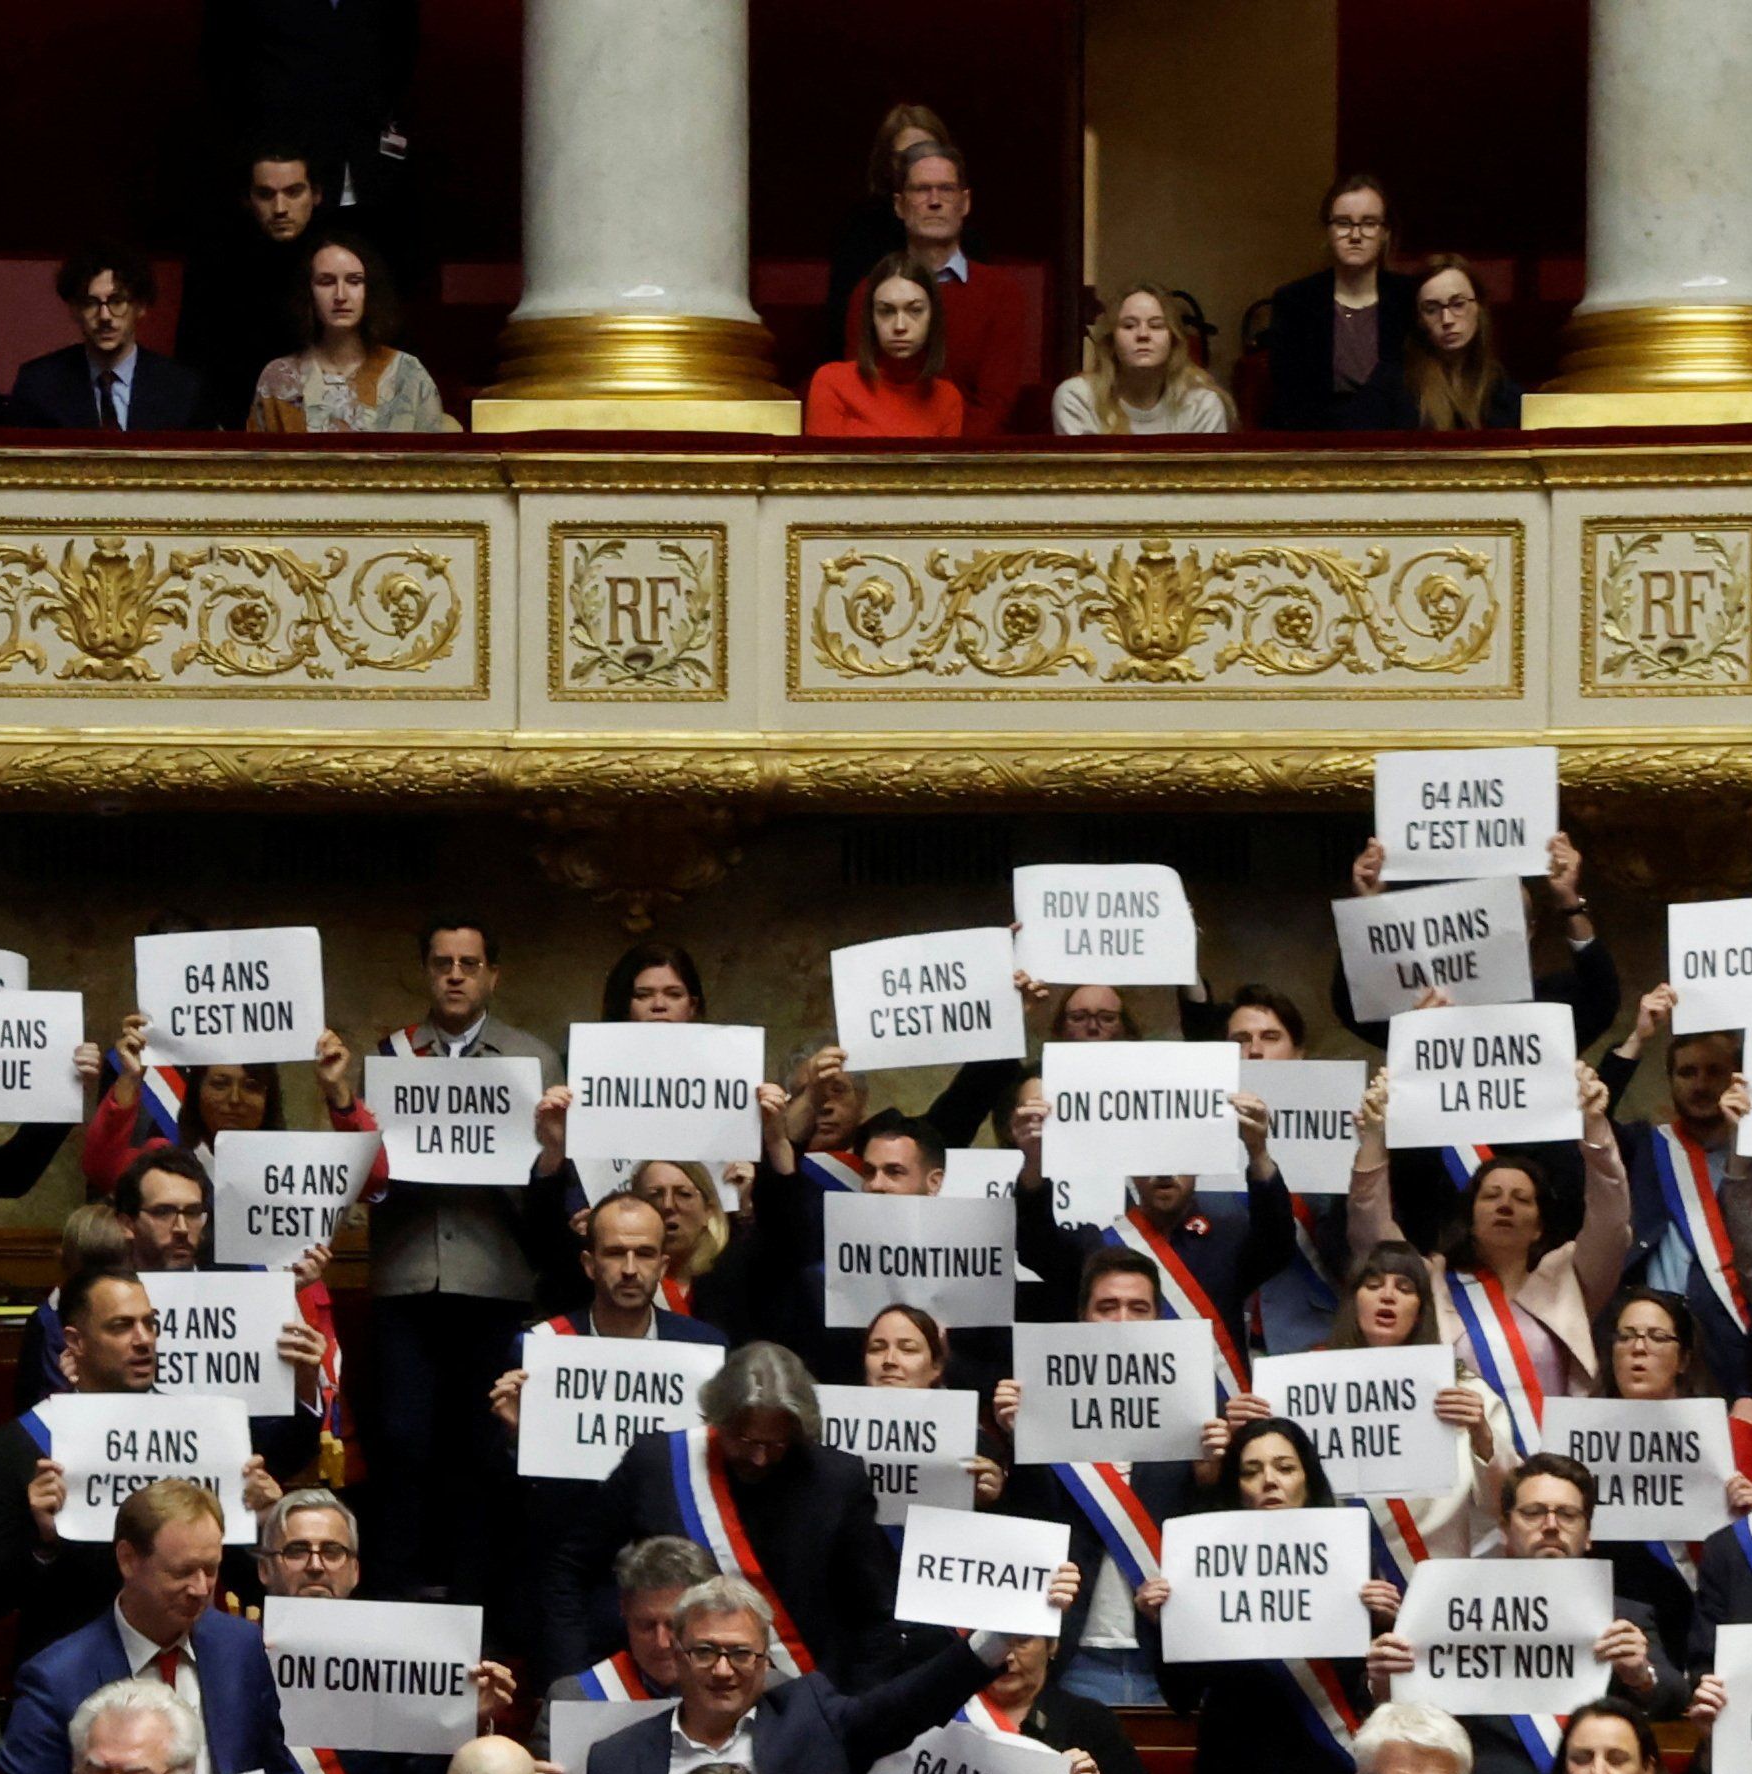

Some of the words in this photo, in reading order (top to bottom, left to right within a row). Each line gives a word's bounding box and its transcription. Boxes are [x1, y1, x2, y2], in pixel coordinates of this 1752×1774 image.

[604, 576, 681, 646] RF
[1638, 570, 1715, 640] RF
[186, 965, 215, 993] 64
[223, 961, 269, 991] ANS
[882, 968, 912, 997] 64
[921, 962, 966, 992] ANS
[1685, 951, 1716, 979] ON
[172, 1004, 235, 1036] C'EST
[243, 1001, 292, 1032] NON
[871, 1005, 933, 1038] C'EST
[942, 1000, 991, 1032] NON
[1416, 1038, 1464, 1070] RDV
[1474, 1034, 1541, 1067] DANS
[395, 1086, 439, 1114] RDV
[448, 1086, 510, 1114] DANS
[580, 1076, 706, 1112] CONTINUE
[715, 1079, 747, 1110] ON
[1057, 1092, 1089, 1122] ON
[1099, 1090, 1223, 1121] CONTINUE
[1441, 1081, 1470, 1112] LA
[1478, 1078, 1526, 1110] RUE
[417, 1125, 442, 1153] LA
[451, 1125, 494, 1154] RUE
[265, 1165, 294, 1194] 64
[303, 1165, 348, 1196] ANS
[248, 1205, 313, 1236] C'EST
[839, 1243, 871, 1274] ON
[879, 1246, 1002, 1277] CONTINUE
[556, 1368, 607, 1400] RDV
[615, 1371, 683, 1405] DANS
[1047, 1355, 1097, 1386] RDV
[1107, 1353, 1175, 1385] DANS
[577, 1413, 606, 1445] LA
[1072, 1398, 1102, 1429] LA
[1111, 1397, 1160, 1428] RUE
[107, 1430, 138, 1461] 64
[147, 1430, 197, 1464] ANS
[918, 1554, 1051, 1591] RETRAIT
[1197, 1545, 1247, 1577] RDV
[1258, 1543, 1327, 1576] DANS
[1221, 1591, 1251, 1622] LA
[1261, 1589, 1310, 1622] RUE
[1449, 1598, 1483, 1632] 64
[1492, 1597, 1548, 1632] ANS
[278, 1654, 315, 1688] ON
[325, 1657, 464, 1696] CONTINUE
[1429, 1643, 1507, 1678] C'EST
[1515, 1644, 1574, 1678] NON
